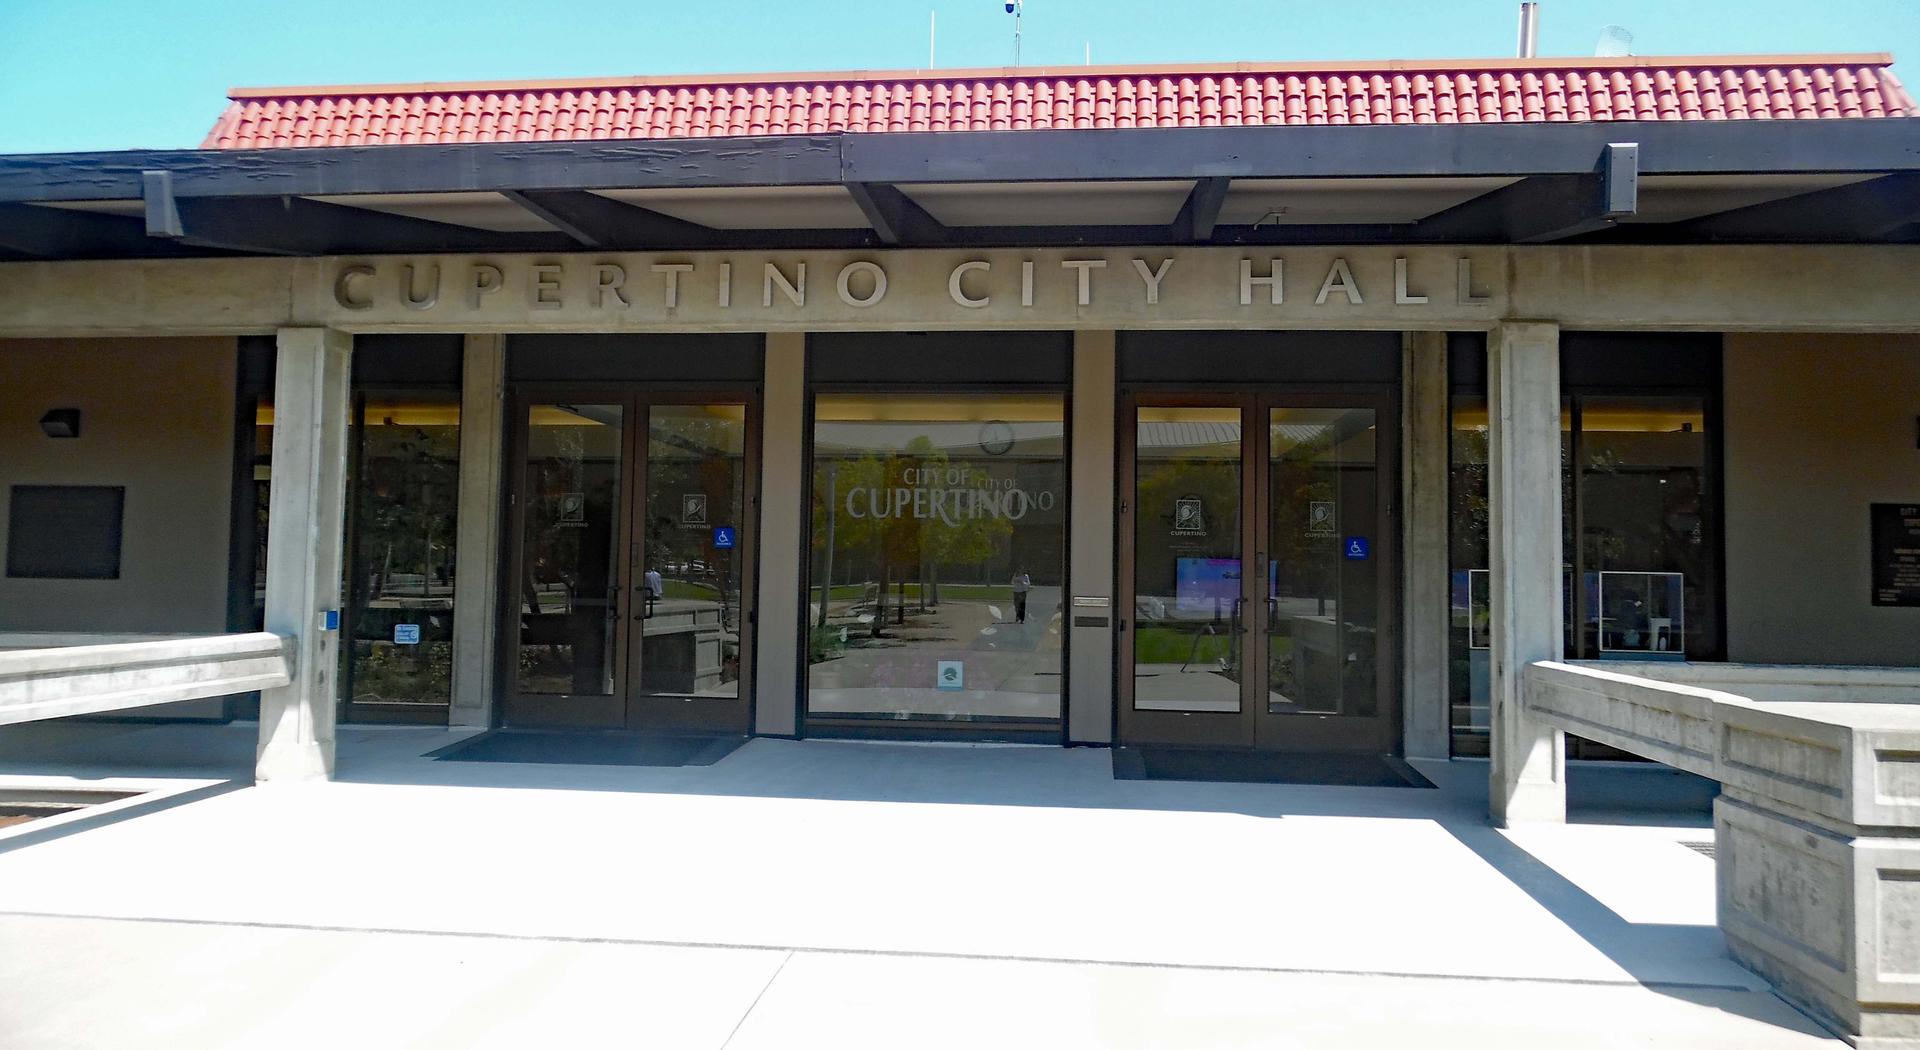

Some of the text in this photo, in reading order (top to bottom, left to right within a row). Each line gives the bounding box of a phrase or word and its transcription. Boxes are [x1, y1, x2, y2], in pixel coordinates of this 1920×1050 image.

[333, 258, 1491, 311] CUPERTINO CITY HALL
[903, 468, 970, 486] CITY OF
[846, 487, 1028, 528] CUPERTINO
